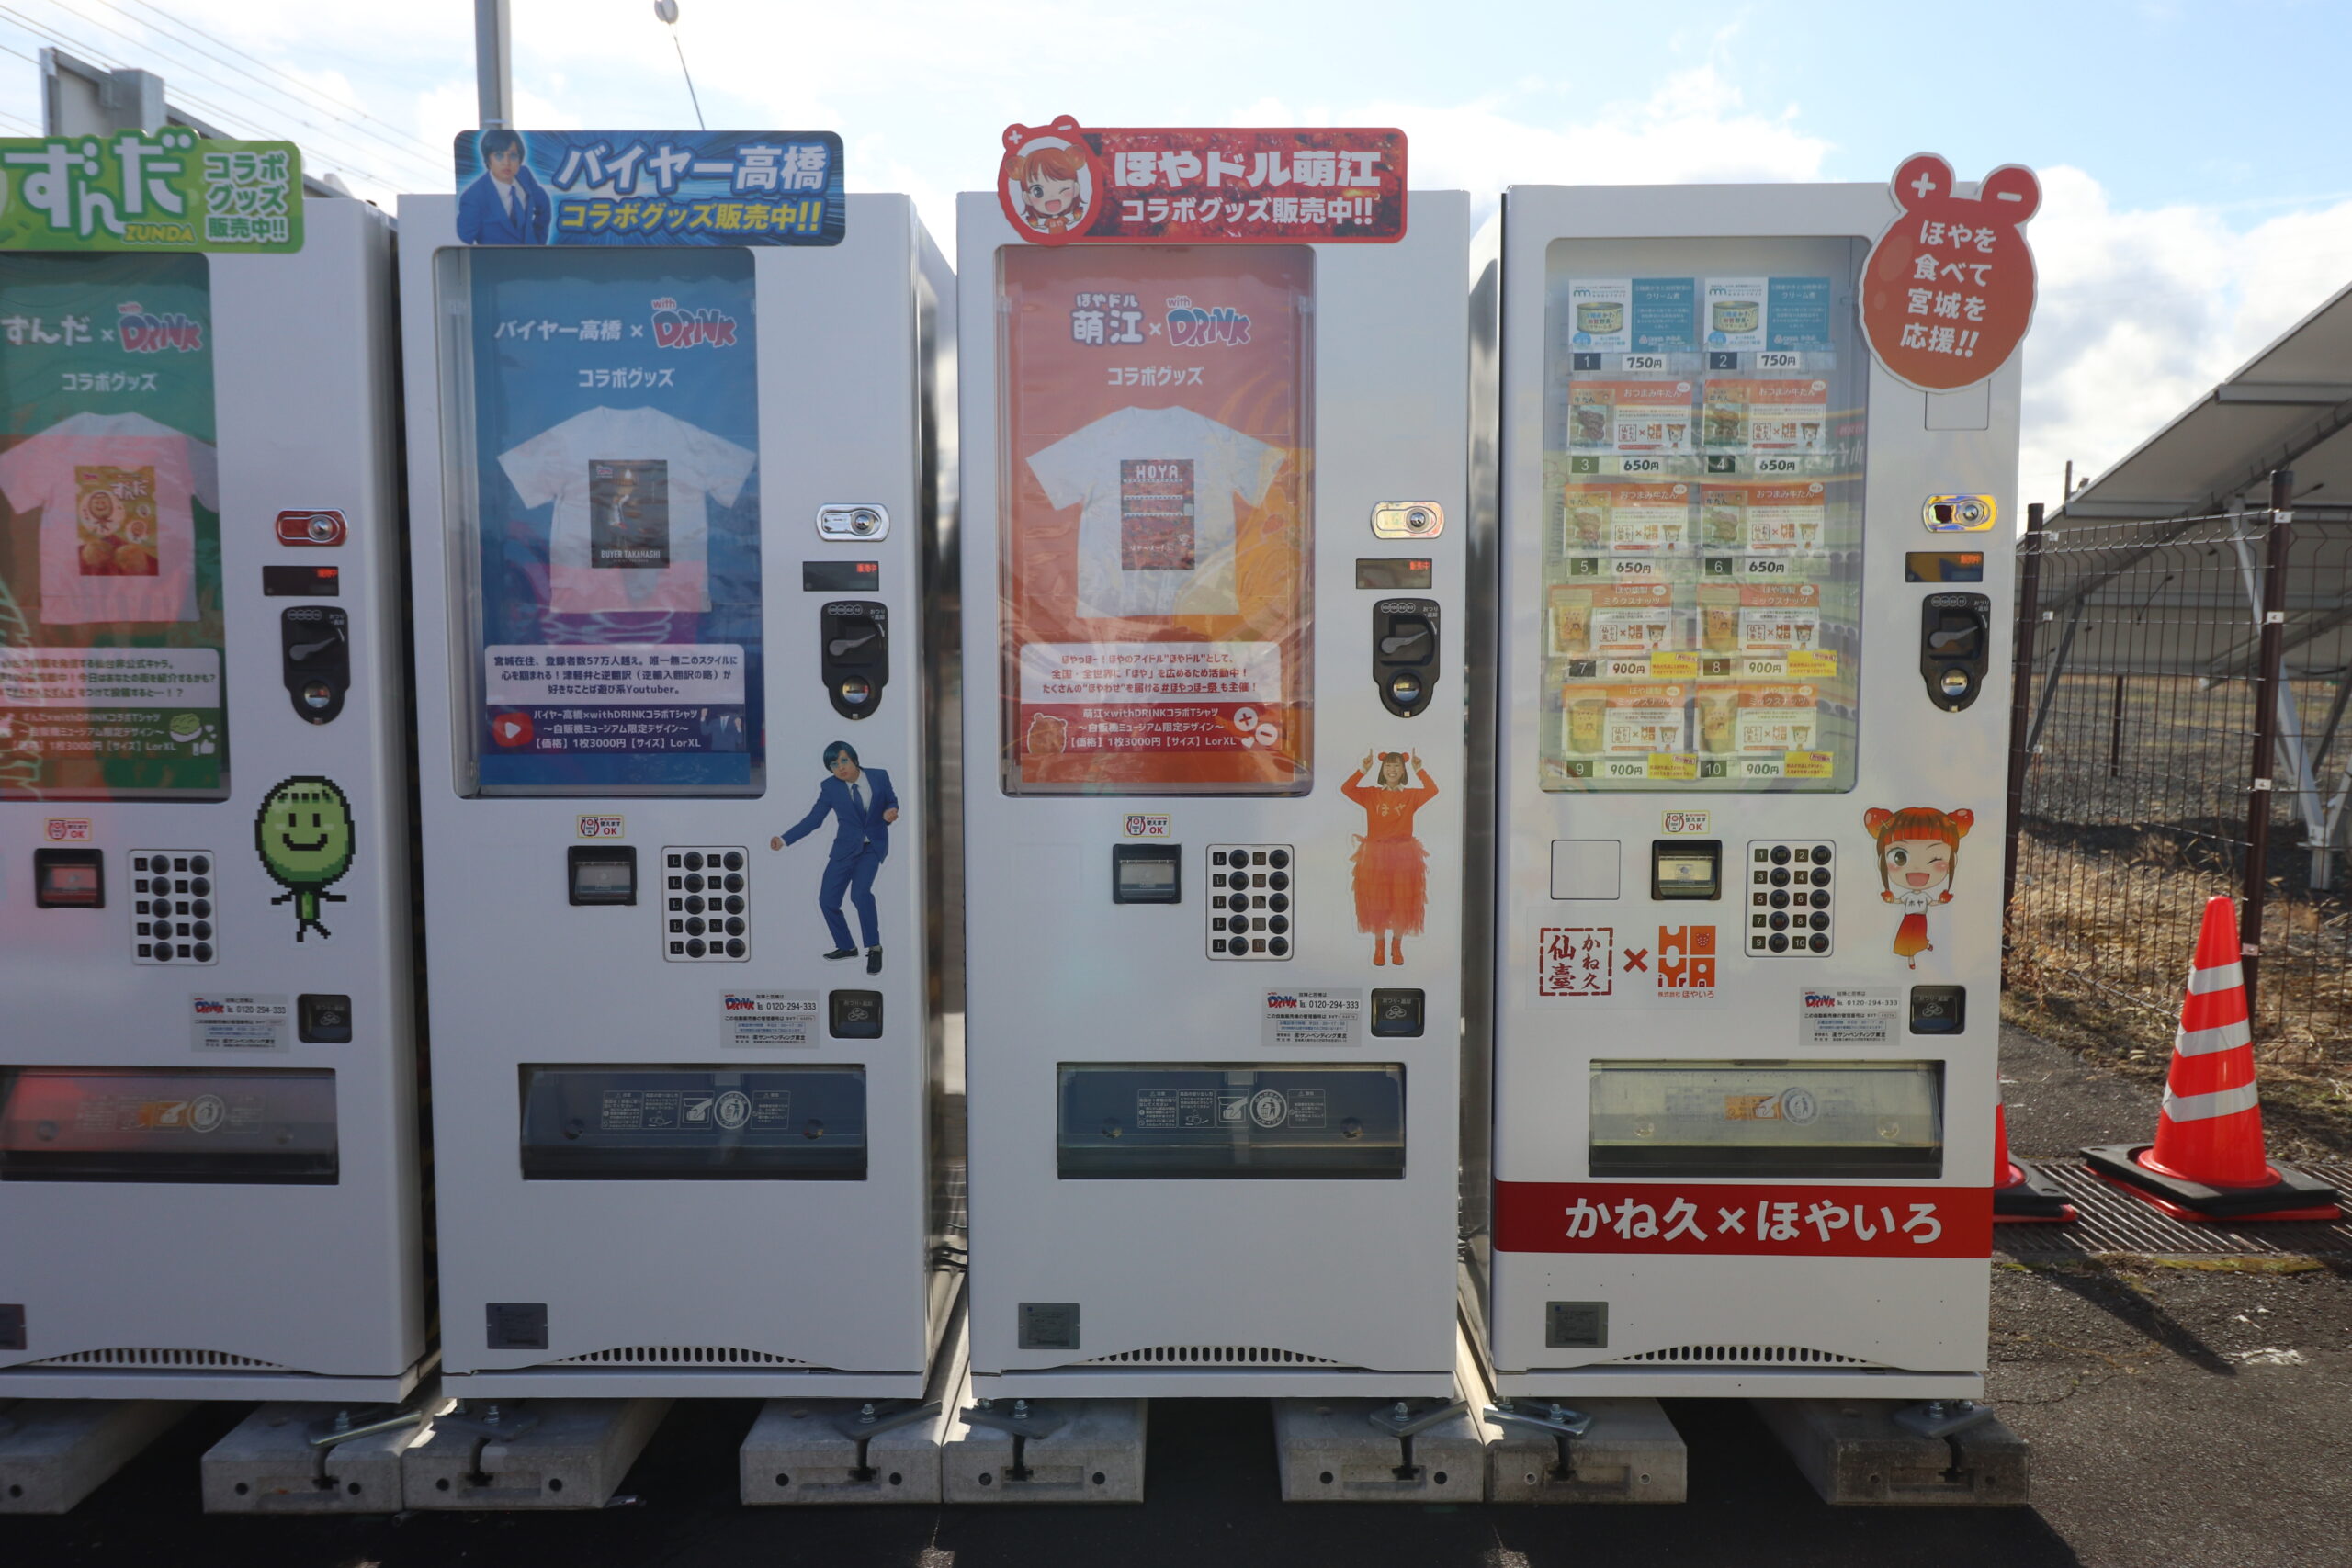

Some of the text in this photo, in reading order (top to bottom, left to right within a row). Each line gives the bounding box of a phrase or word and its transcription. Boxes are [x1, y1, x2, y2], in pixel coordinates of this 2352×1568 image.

[204, 152, 288, 183] コラボ
[557, 143, 827, 191] バイヤー高橋
[1114, 151, 1382, 188] ほやドル萌江
[5, 134, 192, 237] ずんだ
[206, 184, 288, 215] グッズ
[560, 201, 821, 232] コラボグッズ販売中!!
[1121, 197, 1374, 226] コラボグッズ販売中!!
[124, 223, 195, 243] ZUNDA
[1919, 220, 1997, 253] ほやを
[1913, 254, 1993, 287] 食べて
[651, 298, 677, 310] with
[1075, 293, 1139, 309] ほやドル
[1166, 295, 1192, 309] with
[1907, 288, 1987, 321] 宮城を
[118, 313, 204, 353] DRINK
[494, 319, 623, 342] バイヤー高橋
[651, 309, 737, 349] DRINK
[1071, 310, 1145, 344] 萌江
[1165, 307, 1251, 347] DRINK
[1900, 322, 1980, 357] 応援!!
[1584, 356, 1590, 367] 1
[1626, 356, 1662, 369] 750円
[1719, 355, 1727, 367] 2
[1761, 355, 1797, 367] 750円
[61, 372, 158, 393] コラボグッズ
[578, 367, 675, 389] コラボグッズ
[1107, 366, 1204, 387] コラボグッズ
[1580, 459, 1589, 471] 3
[1623, 460, 1660, 471] 650円
[1716, 458, 1725, 470] 4
[1759, 459, 1796, 471] 650円
[1136, 465, 1179, 479] HOYA
[601, 549, 662, 559] BUYER TAKAHASHI
[1579, 561, 1589, 572] 5
[1615, 561, 1652, 574] 650円
[1714, 561, 1724, 573] 6
[1748, 561, 1785, 573] 650円
[1578, 662, 1587, 674] 7
[1612, 662, 1645, 675] 900円
[1712, 660, 1721, 673] 8
[1748, 661, 1781, 674] 900円
[1576, 763, 1584, 775] 9
[1610, 764, 1643, 775] 900円
[1705, 762, 1721, 775] 10
[1746, 763, 1779, 775] 900円
[604, 827, 617, 836] OK
[1149, 827, 1163, 835] OK
[1688, 823, 1702, 831] OK
[1547, 934, 1577, 990] 仙臺
[1581, 934, 1601, 990] かね久
[1682, 990, 1715, 998] ほやいろ
[766, 1002, 817, 1010] 0120-294-333
[1308, 1000, 1360, 1010] 0120-294-333
[1566, 1196, 1943, 1244] かね久×ほやいろ
